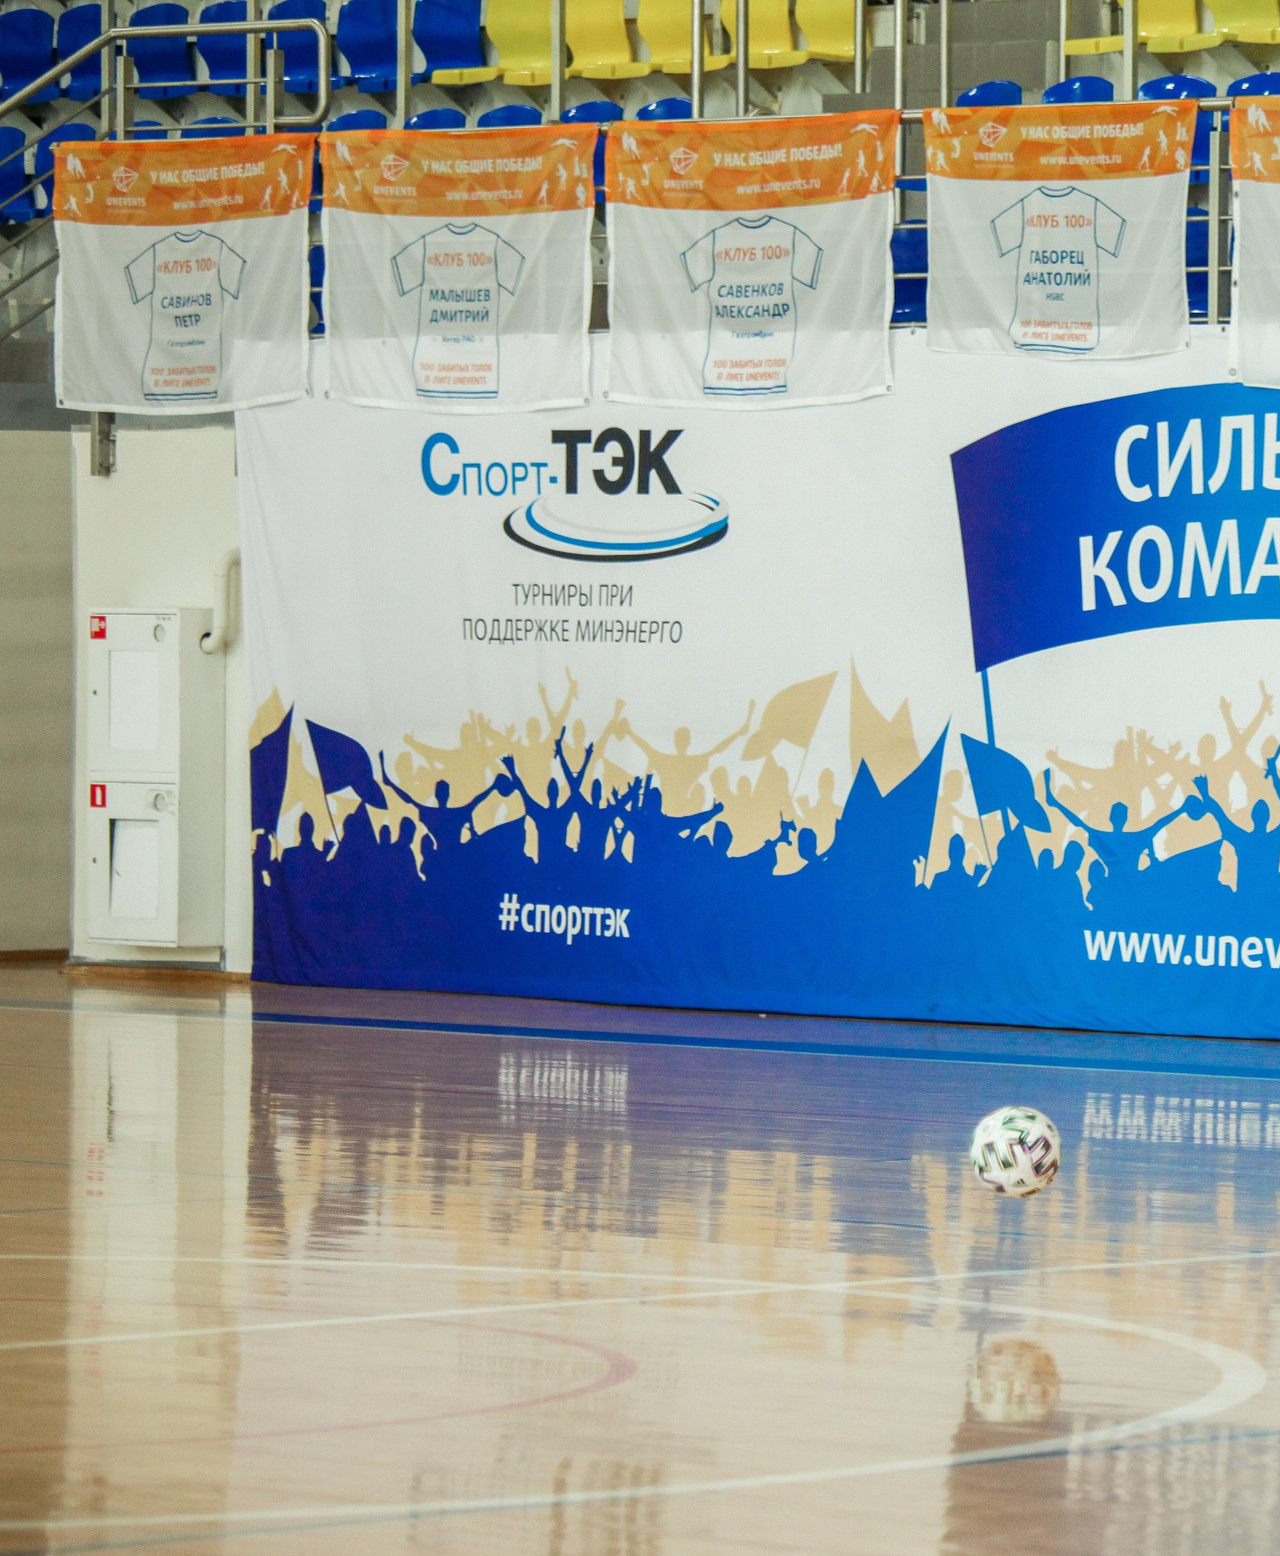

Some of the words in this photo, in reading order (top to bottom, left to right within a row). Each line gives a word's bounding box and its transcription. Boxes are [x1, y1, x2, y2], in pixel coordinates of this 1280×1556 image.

[1020, 127, 1028, 139] У
[1028, 126, 1051, 139] НАС
[1052, 125, 1091, 139] ОБЩИЕ
[1093, 122, 1144, 139] ПОБЕДЫ!
[713, 152, 721, 168] У
[721, 151, 746, 168] НАС
[748, 149, 787, 166] ОБЩИЕ
[789, 143, 843, 162] ПОБЕДЫ!
[973, 152, 1014, 162] UNEVENTS
[1039, 154, 1122, 165] www.unevents.ru
[150, 171, 157, 184] У
[159, 168, 179, 184] НАС
[181, 166, 218, 183] ОБЩИЕ
[220, 162, 265, 178] ПОБЕДЫ!
[421, 159, 429, 173] У
[430, 158, 453, 174] НАС
[455, 157, 493, 173] ОБЩИЕ
[495, 156, 543, 172] ПОБЕДЫ!
[373, 185, 417, 197] UNEVENTS
[663, 179, 704, 190] UNEVENTS
[736, 179, 821, 195] www.unevents.ru
[106, 197, 147, 207] UNEVENTS
[445, 189, 524, 201] www.unevents.ru
[1026, 214, 1059, 228] «КЛУБ
[427, 252, 464, 267] «КЛУБ
[716, 247, 756, 262] «КЛУБ
[1029, 250, 1085, 267] ГАБОРЕЦ
[156, 260, 192, 274] «КЛУБ
[1023, 269, 1091, 287] АНАТОЛИЙ
[429, 289, 491, 303] МАЛЫШЕВ
[717, 282, 785, 299] САВЕНКОВ
[161, 294, 212, 310] САВИНОВ
[429, 307, 490, 325] ДМИТРИЙ
[715, 303, 791, 319] АЛЕКСАНДР
[174, 314, 200, 328] ПЕТР
[512, 583, 592, 607] ТУРНИРЫ
[600, 584, 634, 607] ПРИ
[462, 618, 570, 646] ПОДДЕРЖКЕ
[575, 620, 683, 644] МИНЭНЕРГО
[498, 893, 631, 945] #спорттэк
